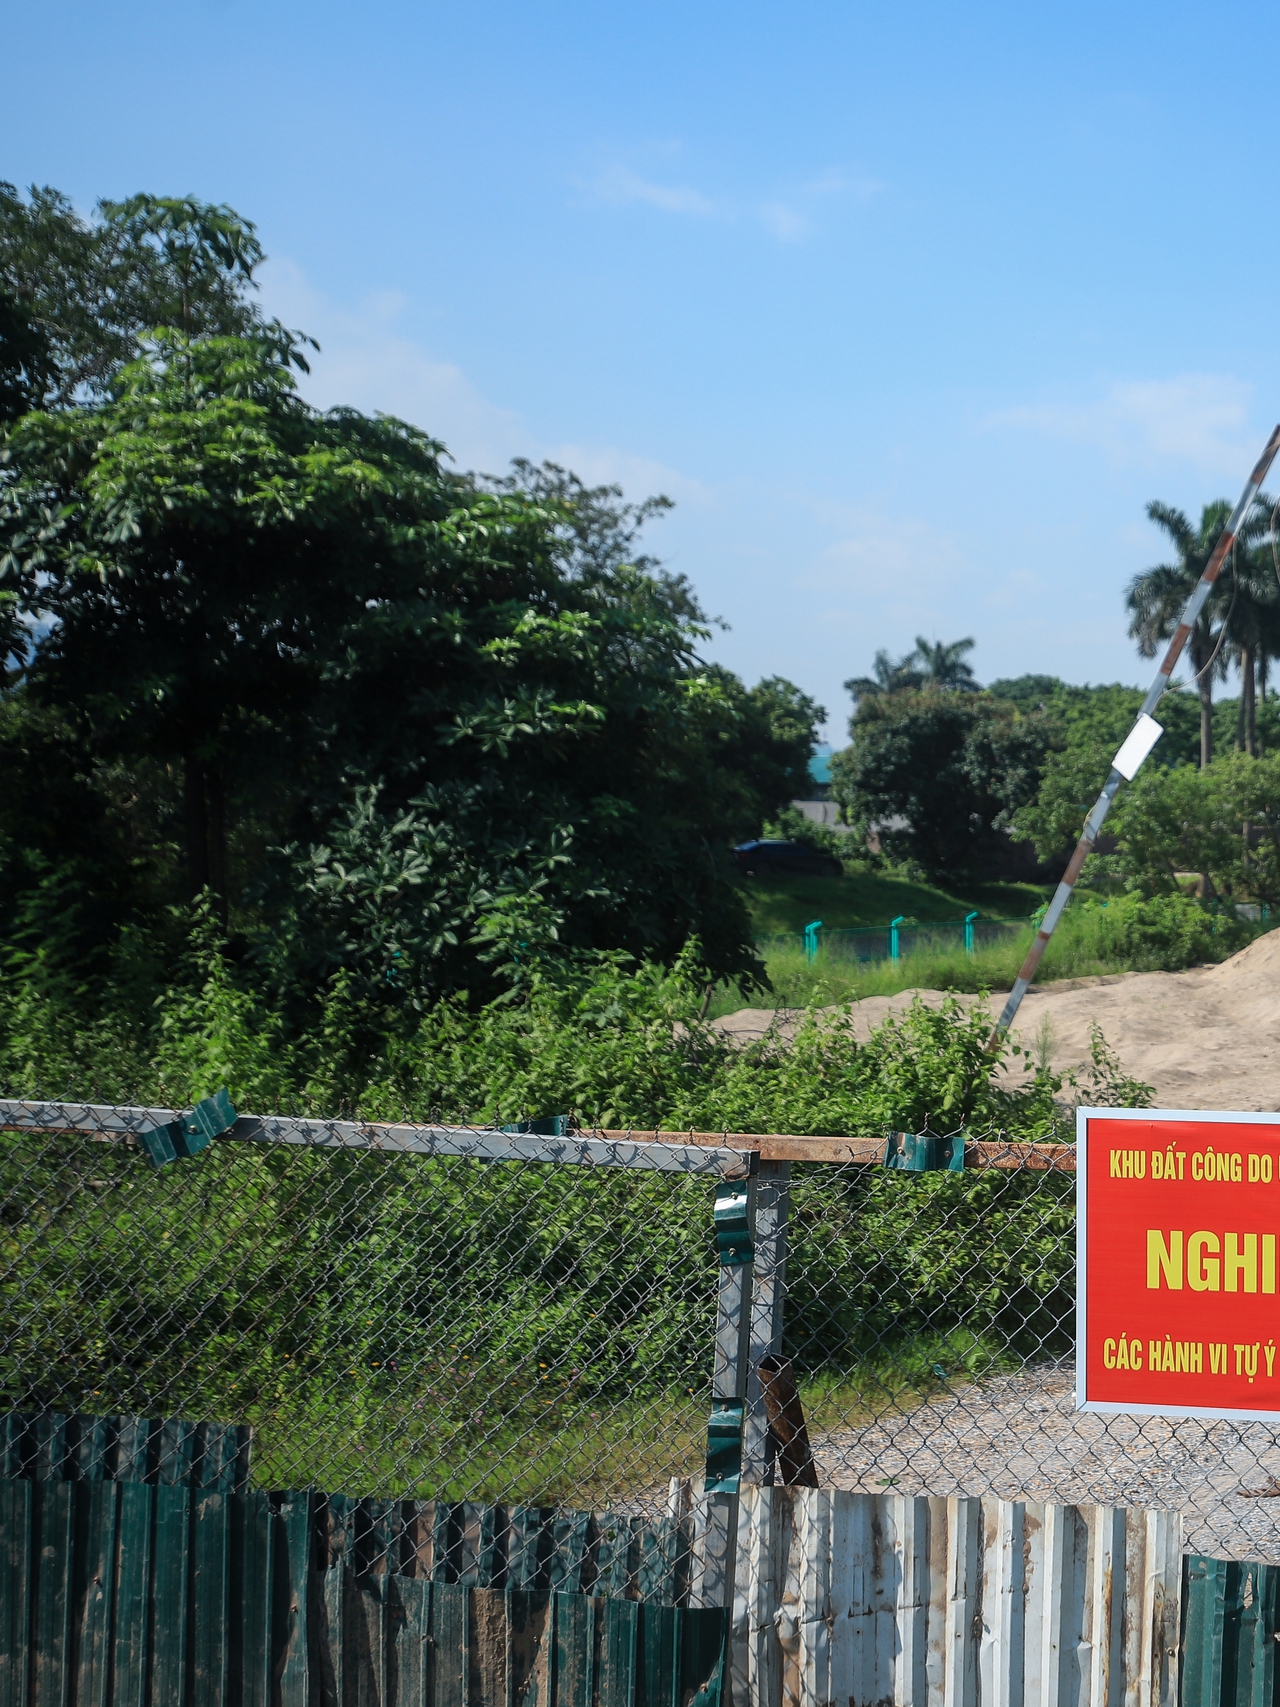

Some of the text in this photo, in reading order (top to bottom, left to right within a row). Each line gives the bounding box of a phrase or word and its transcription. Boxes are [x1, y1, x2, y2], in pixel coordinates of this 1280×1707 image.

[1109, 1149, 1146, 1180] KHU
[1150, 1140, 1187, 1181] ĐẤT
[1191, 1146, 1242, 1183] CÔNG
[1247, 1153, 1273, 1184] DO
[1103, 1331, 1143, 1371] CÁC
[1148, 1334, 1203, 1374] HÀNH
[1208, 1342, 1228, 1375] VI
[1233, 1341, 1261, 1384] TỰ
[1263, 1339, 1277, 1377] Ý
